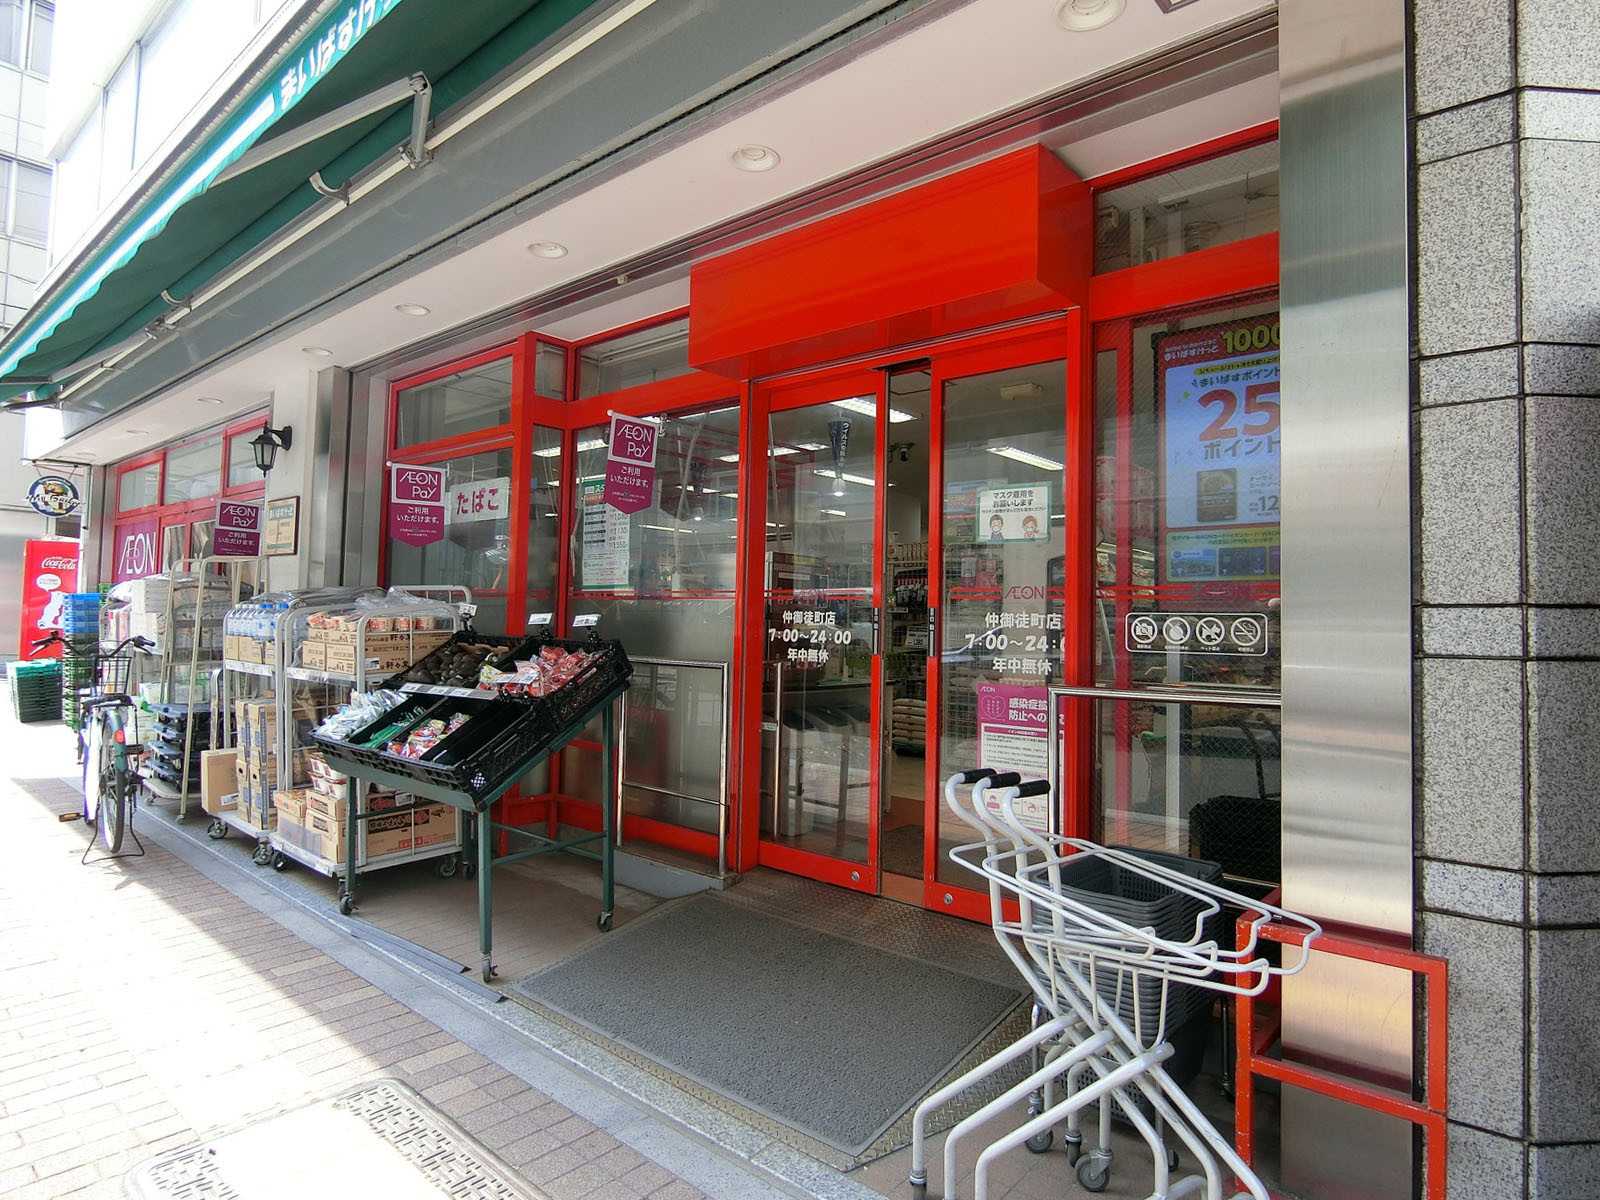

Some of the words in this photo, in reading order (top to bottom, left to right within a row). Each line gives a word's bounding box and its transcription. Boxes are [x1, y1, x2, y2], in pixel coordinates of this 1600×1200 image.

[1198, 381, 1280, 442] 25
[627, 442, 650, 458] Pay
[1203, 435, 1280, 460] ポイント
[621, 466, 641, 477] ご利用
[412, 486, 437, 499] Pay
[993, 490, 1034, 499] マスク着用を
[456, 488, 499, 515] たばこ
[993, 498, 1034, 508] お願いします
[408, 506, 429, 514] ご利用
[232, 516, 255, 527] Pay
[228, 531, 247, 539] ご利用
[782, 610, 836, 625] 仲御徒町店
[984, 610, 1062, 630] 仲御徒町店
[787, 647, 829, 663] 年中無休
[992, 657, 1052, 675] 年中無休
[1008, 709, 1047, 723] 防止への
